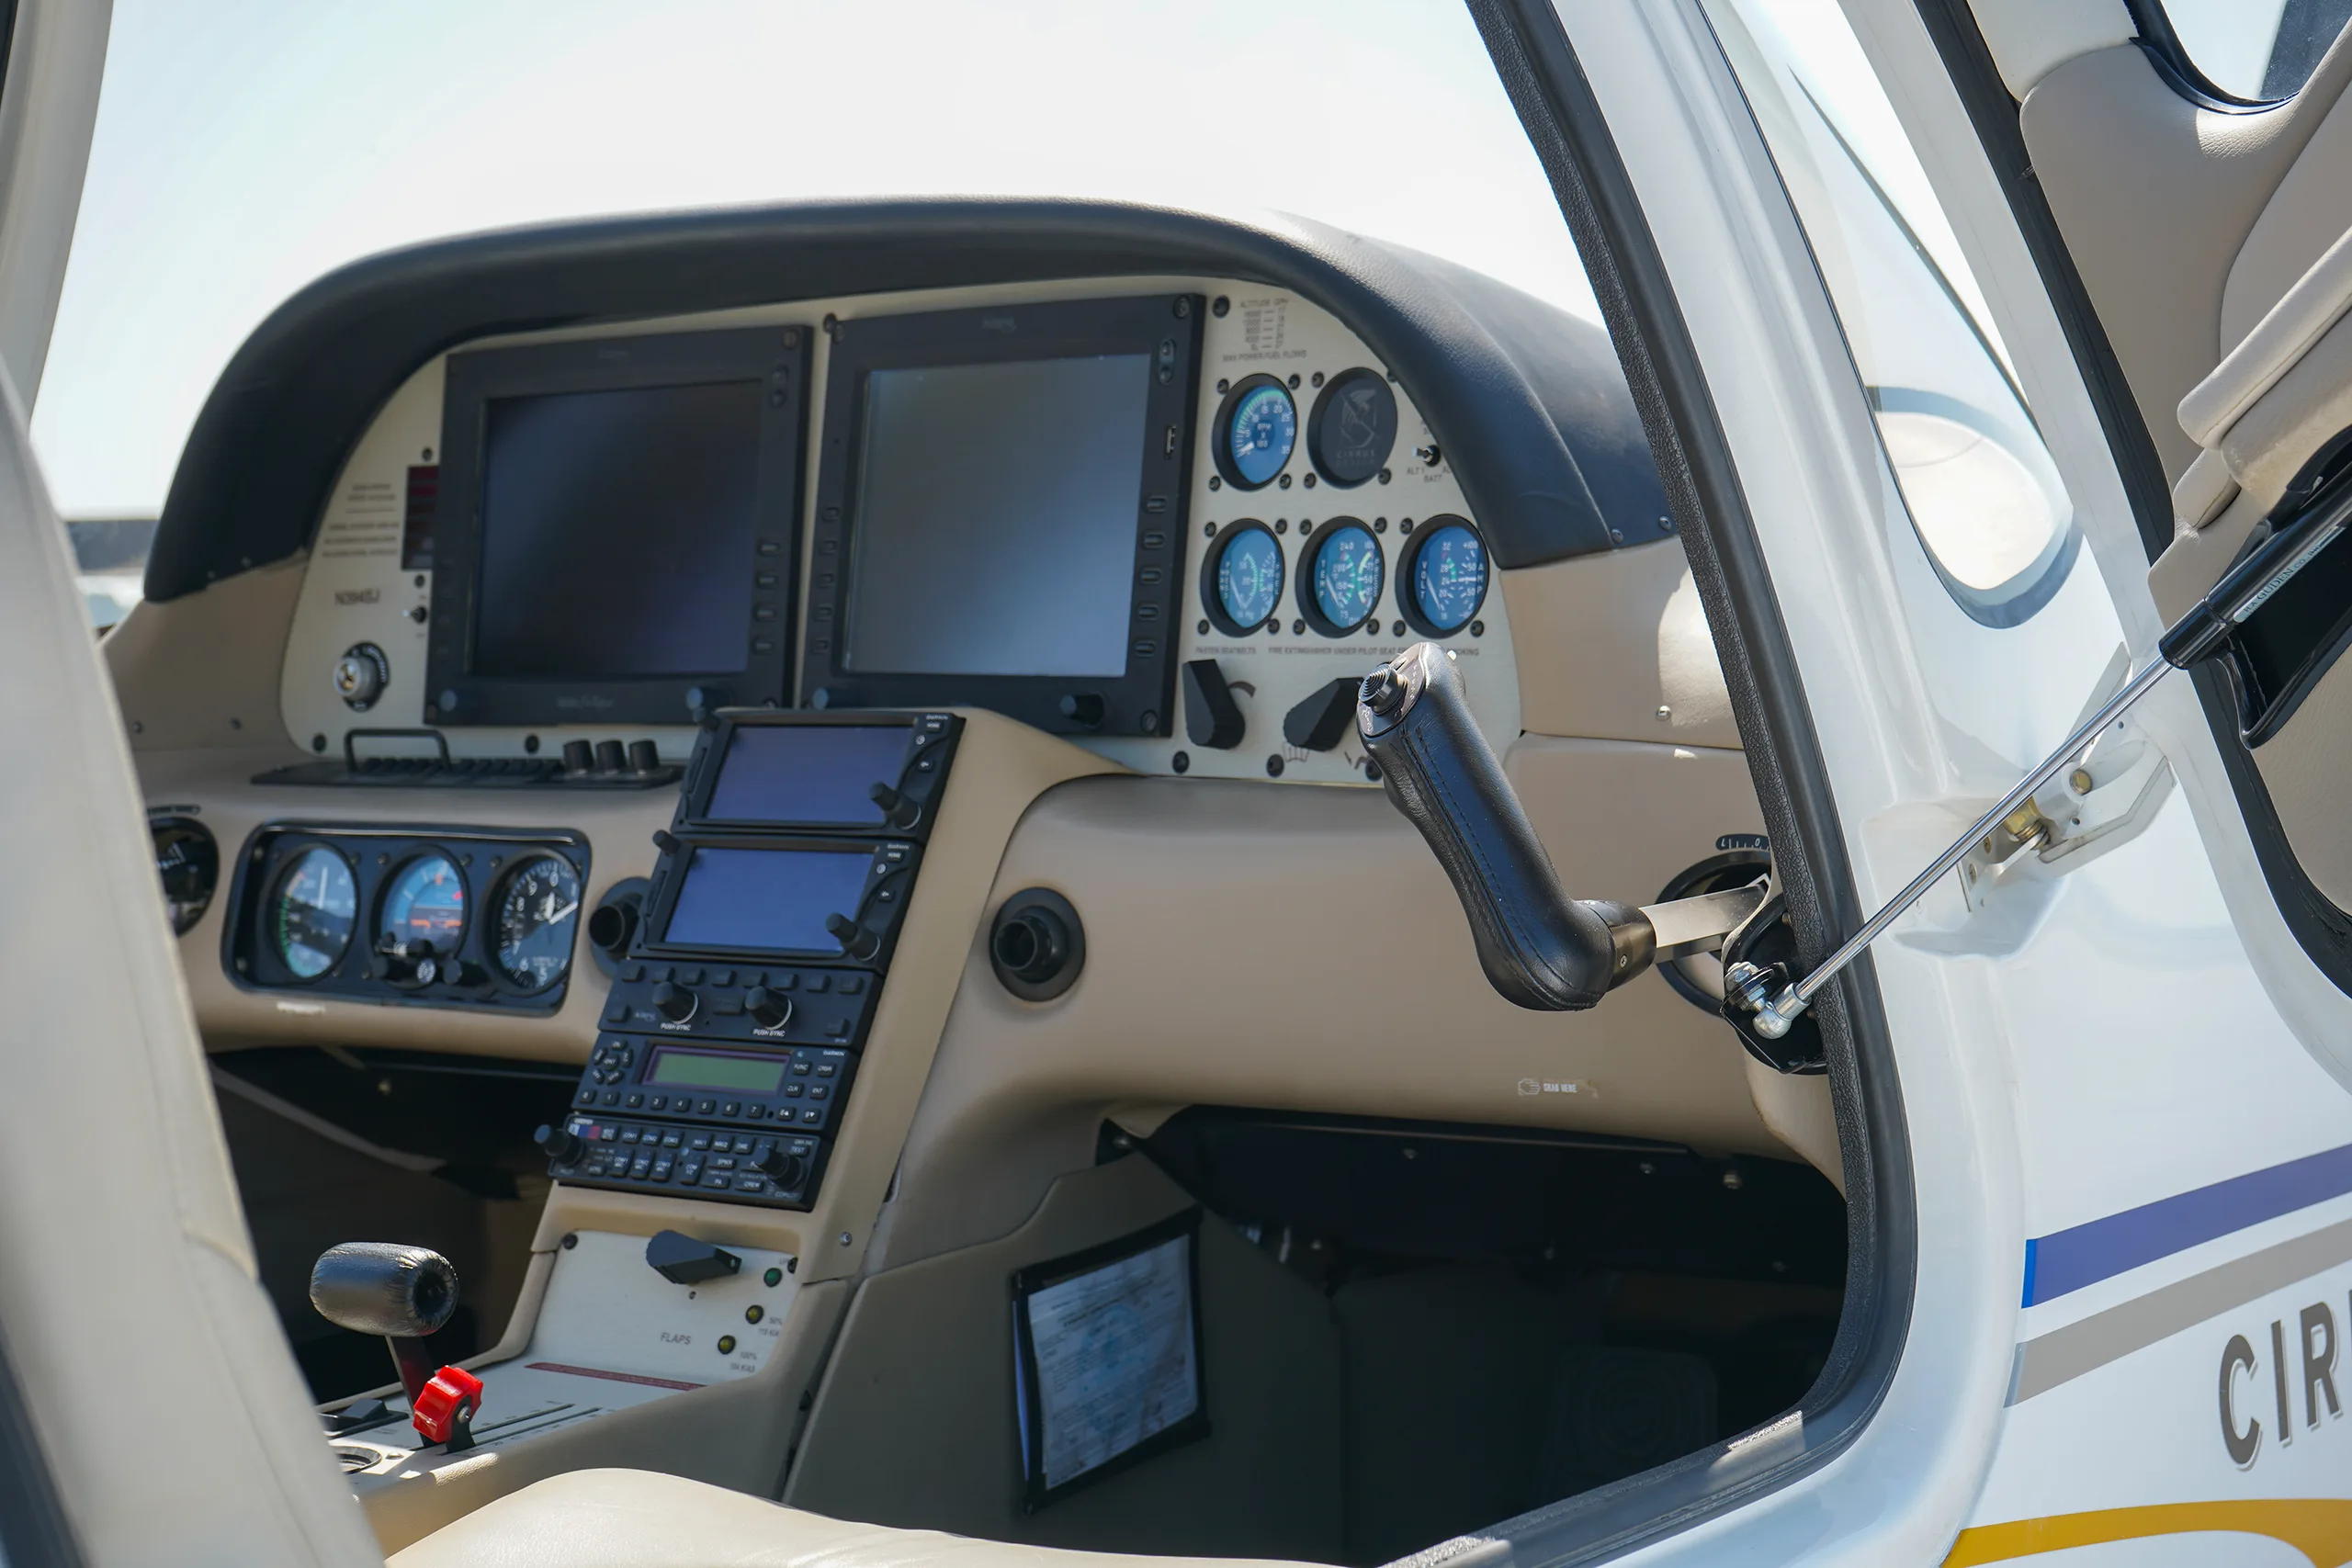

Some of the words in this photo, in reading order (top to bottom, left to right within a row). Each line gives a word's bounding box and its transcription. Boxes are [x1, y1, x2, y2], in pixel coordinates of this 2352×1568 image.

[1340, 541, 1354, 551] 240
[2257, 568, 2294, 600] GUDEN
[1284, 647, 1332, 655] EXTINGUISHER
[1721, 838, 1725, 847] L
[549, 872, 559, 886] 0
[528, 881, 537, 896] 9
[516, 897, 525, 911] 8
[519, 957, 529, 971] 6
[661, 1022, 675, 1031] PUSH
[676, 1023, 691, 1032] SYNC
[1561, 1084, 1577, 1093] HERE
[661, 1332, 692, 1345] FLAPS
[2219, 1289, 2352, 1466] CIR
